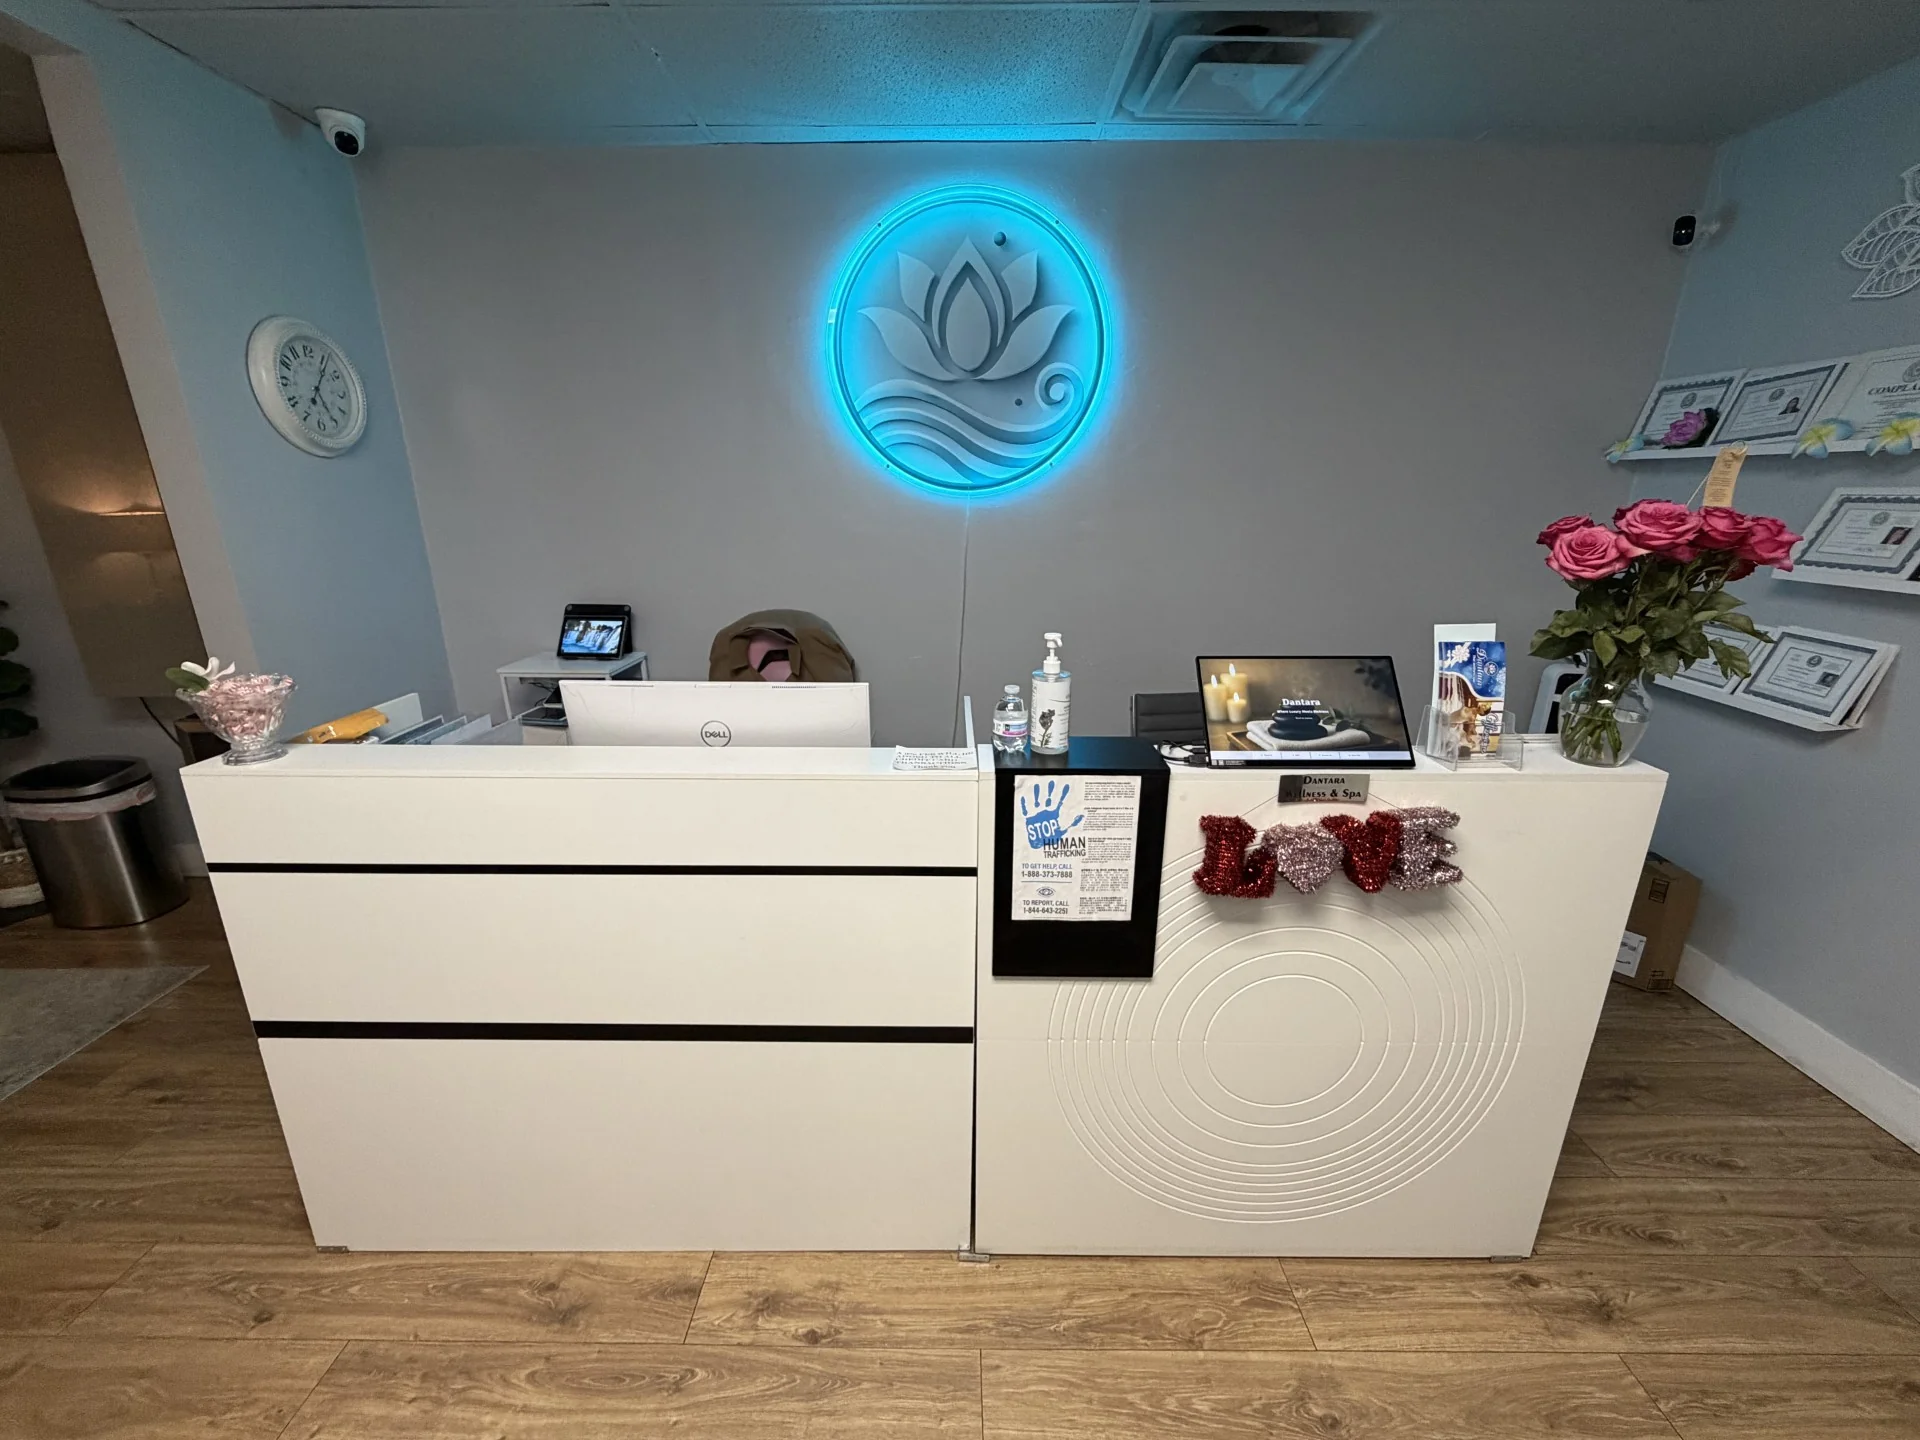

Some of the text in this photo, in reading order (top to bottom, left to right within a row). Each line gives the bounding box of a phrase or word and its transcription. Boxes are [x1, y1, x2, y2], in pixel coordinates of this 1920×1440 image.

[1281, 698, 1321, 706] Dantara
[704, 730, 729, 738] DELL
[1329, 788, 1339, 798] &
[1027, 819, 1058, 841] STOP
[1043, 836, 1086, 851] HUMAN
[1043, 849, 1087, 859] TRAFFICKING
[1021, 870, 1073, 878] 1-888-373-7888
